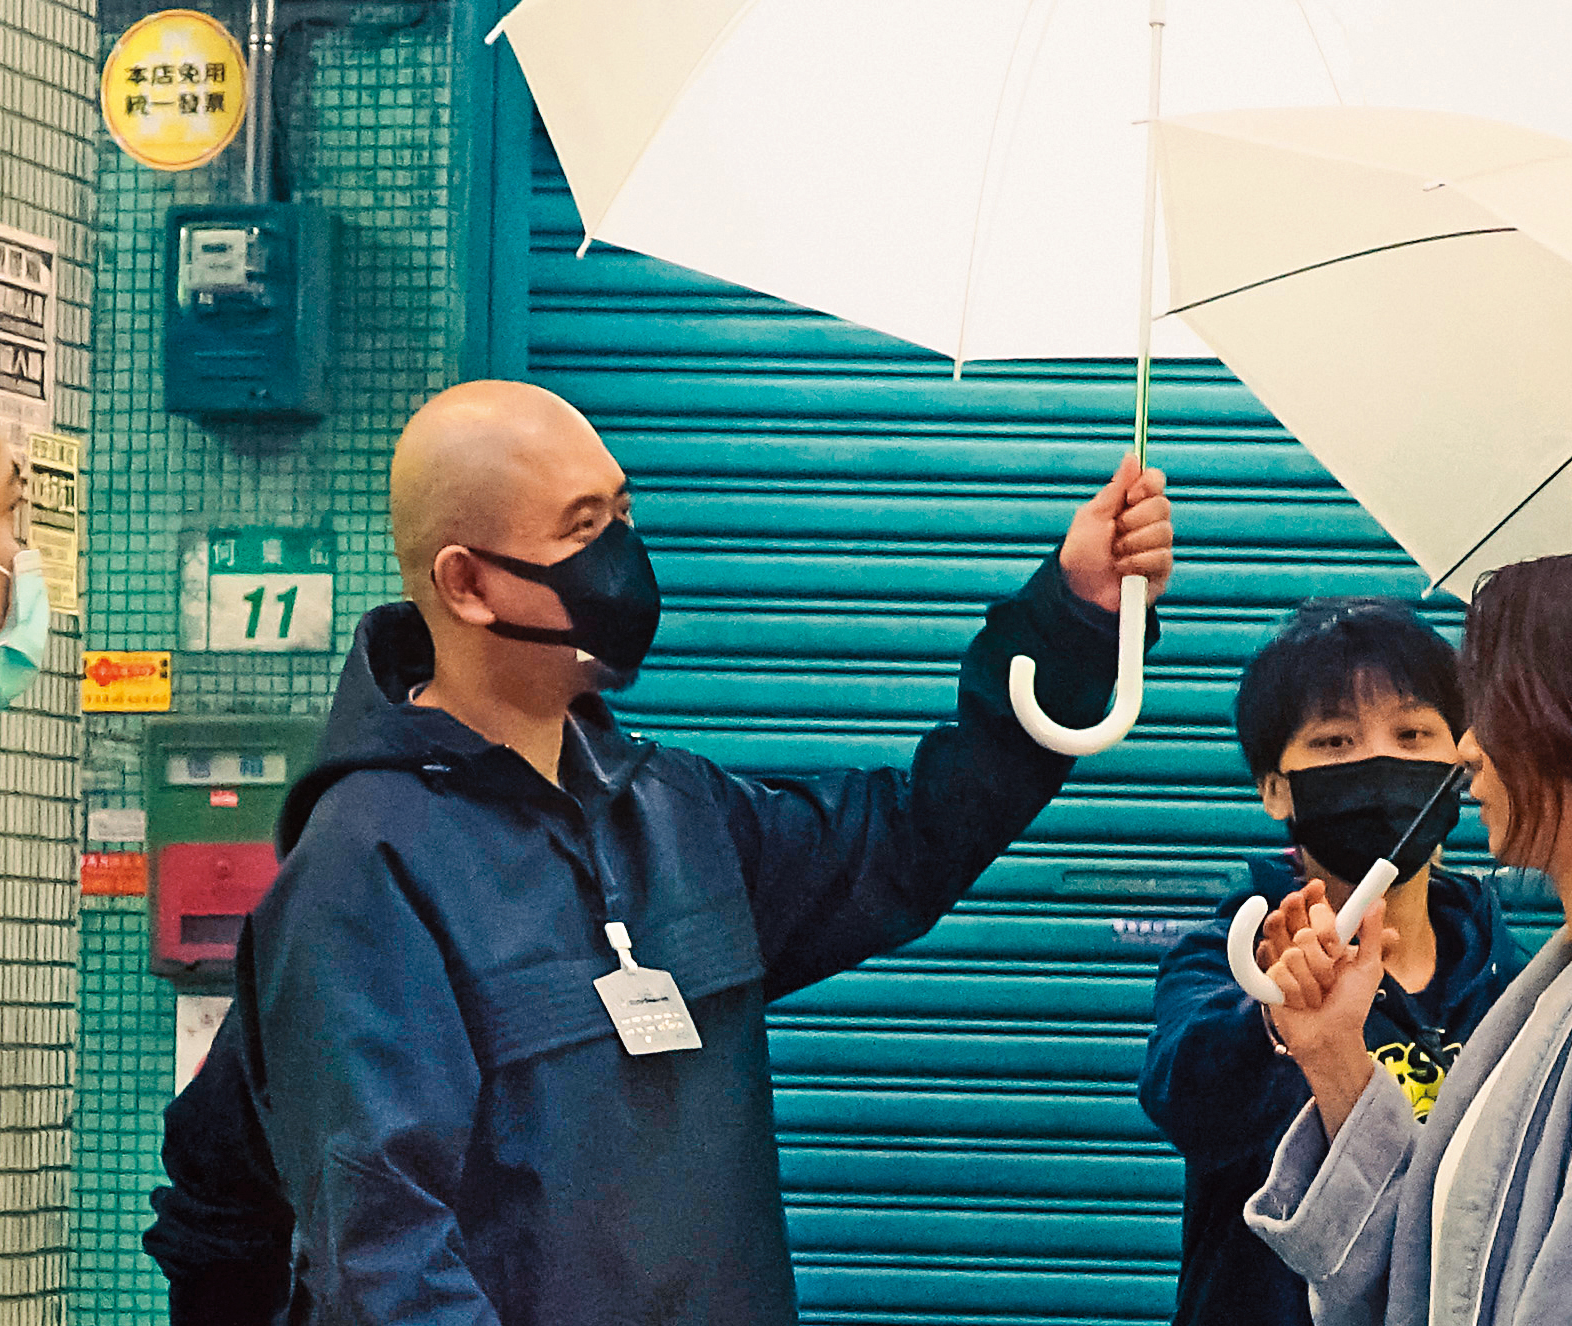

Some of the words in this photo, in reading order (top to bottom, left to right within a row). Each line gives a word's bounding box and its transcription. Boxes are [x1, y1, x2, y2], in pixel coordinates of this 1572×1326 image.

[125, 63, 224, 86] 本店免用
[125, 91, 225, 116] 統一發票
[243, 585, 298, 639] 11
